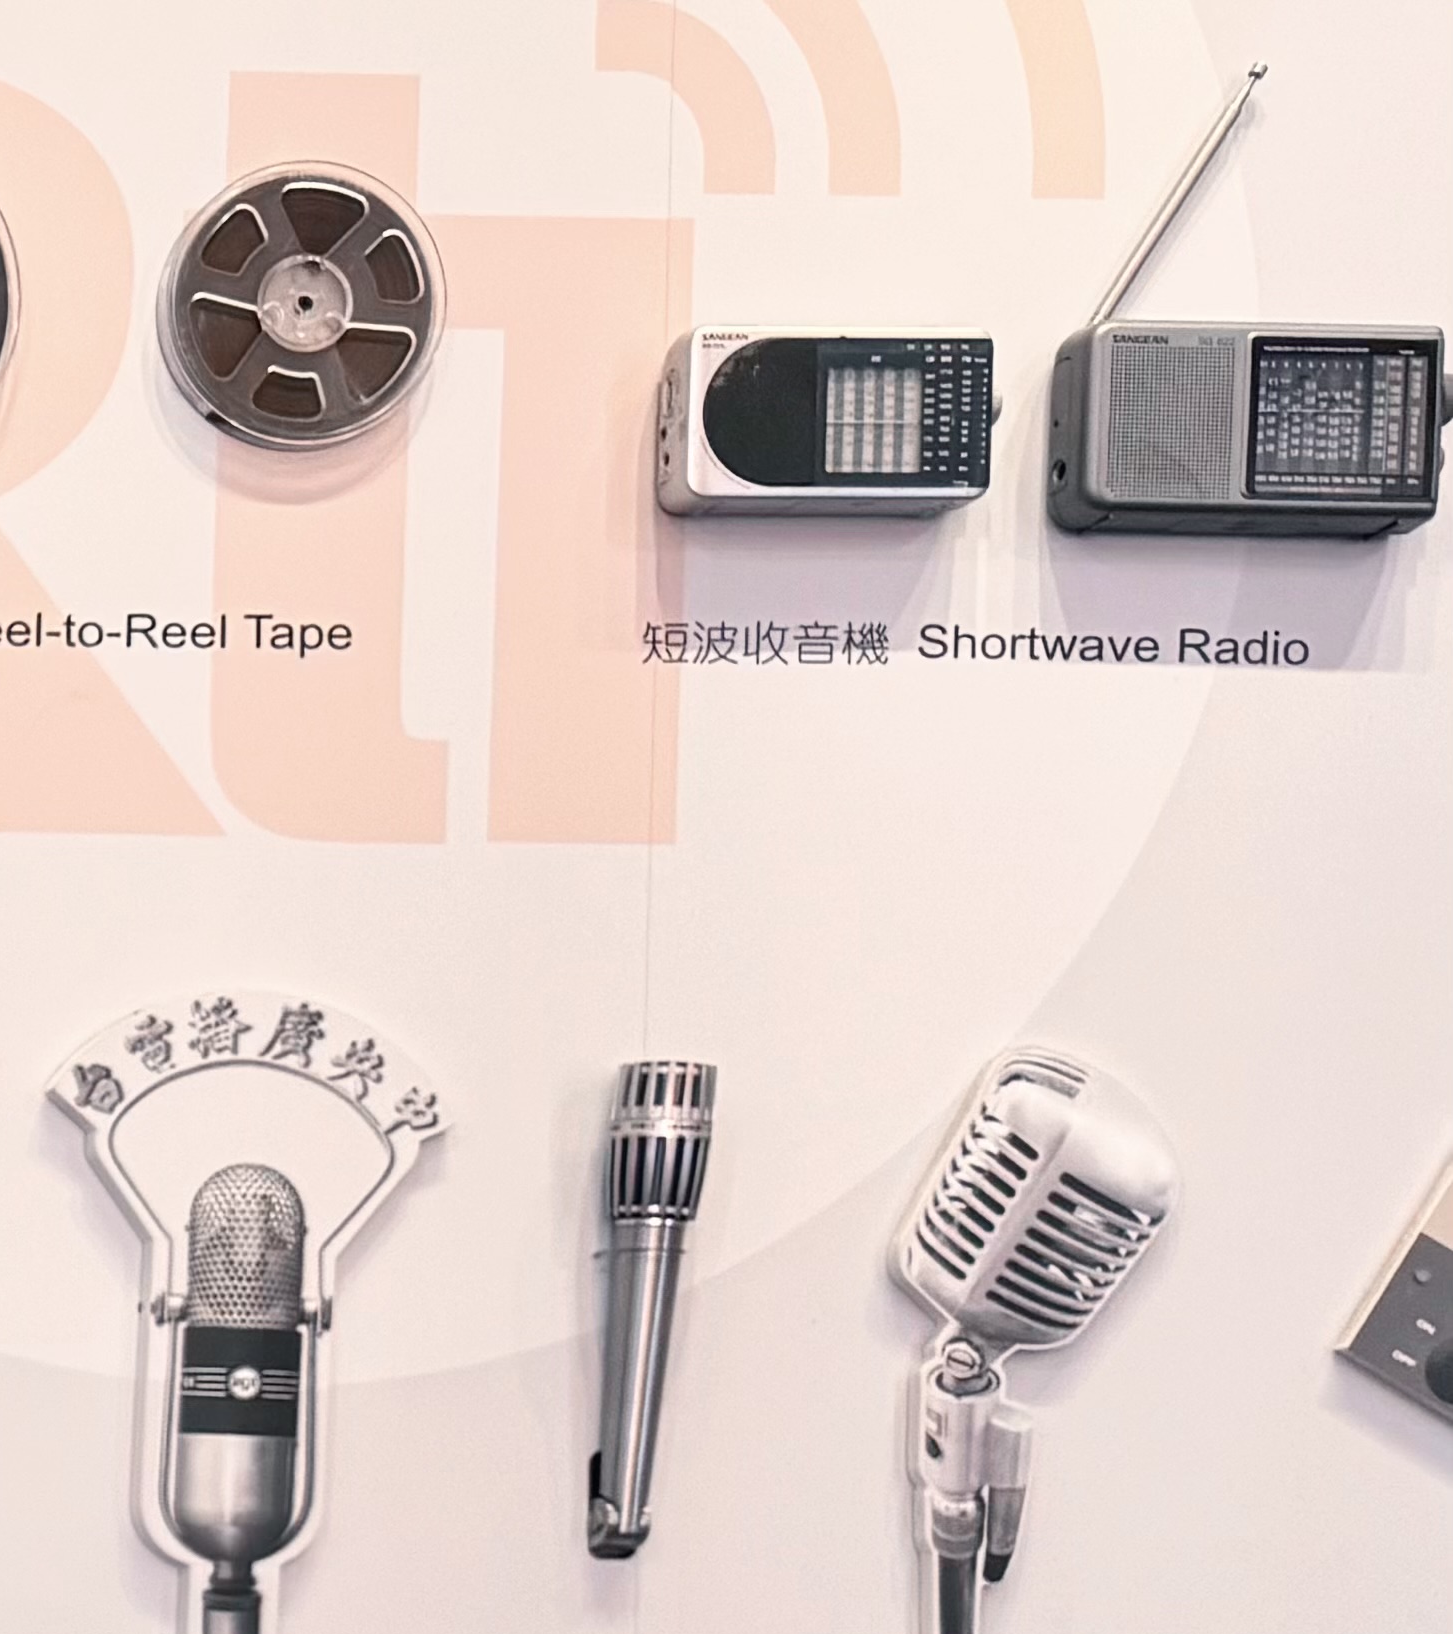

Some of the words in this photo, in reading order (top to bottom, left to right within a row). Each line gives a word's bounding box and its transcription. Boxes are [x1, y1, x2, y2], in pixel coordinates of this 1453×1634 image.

[243, 614, 352, 659] Tape
[642, 621, 889, 665] 短波收音機
[918, 624, 1159, 663] Shortwave
[1178, 628, 1309, 666] Radio
